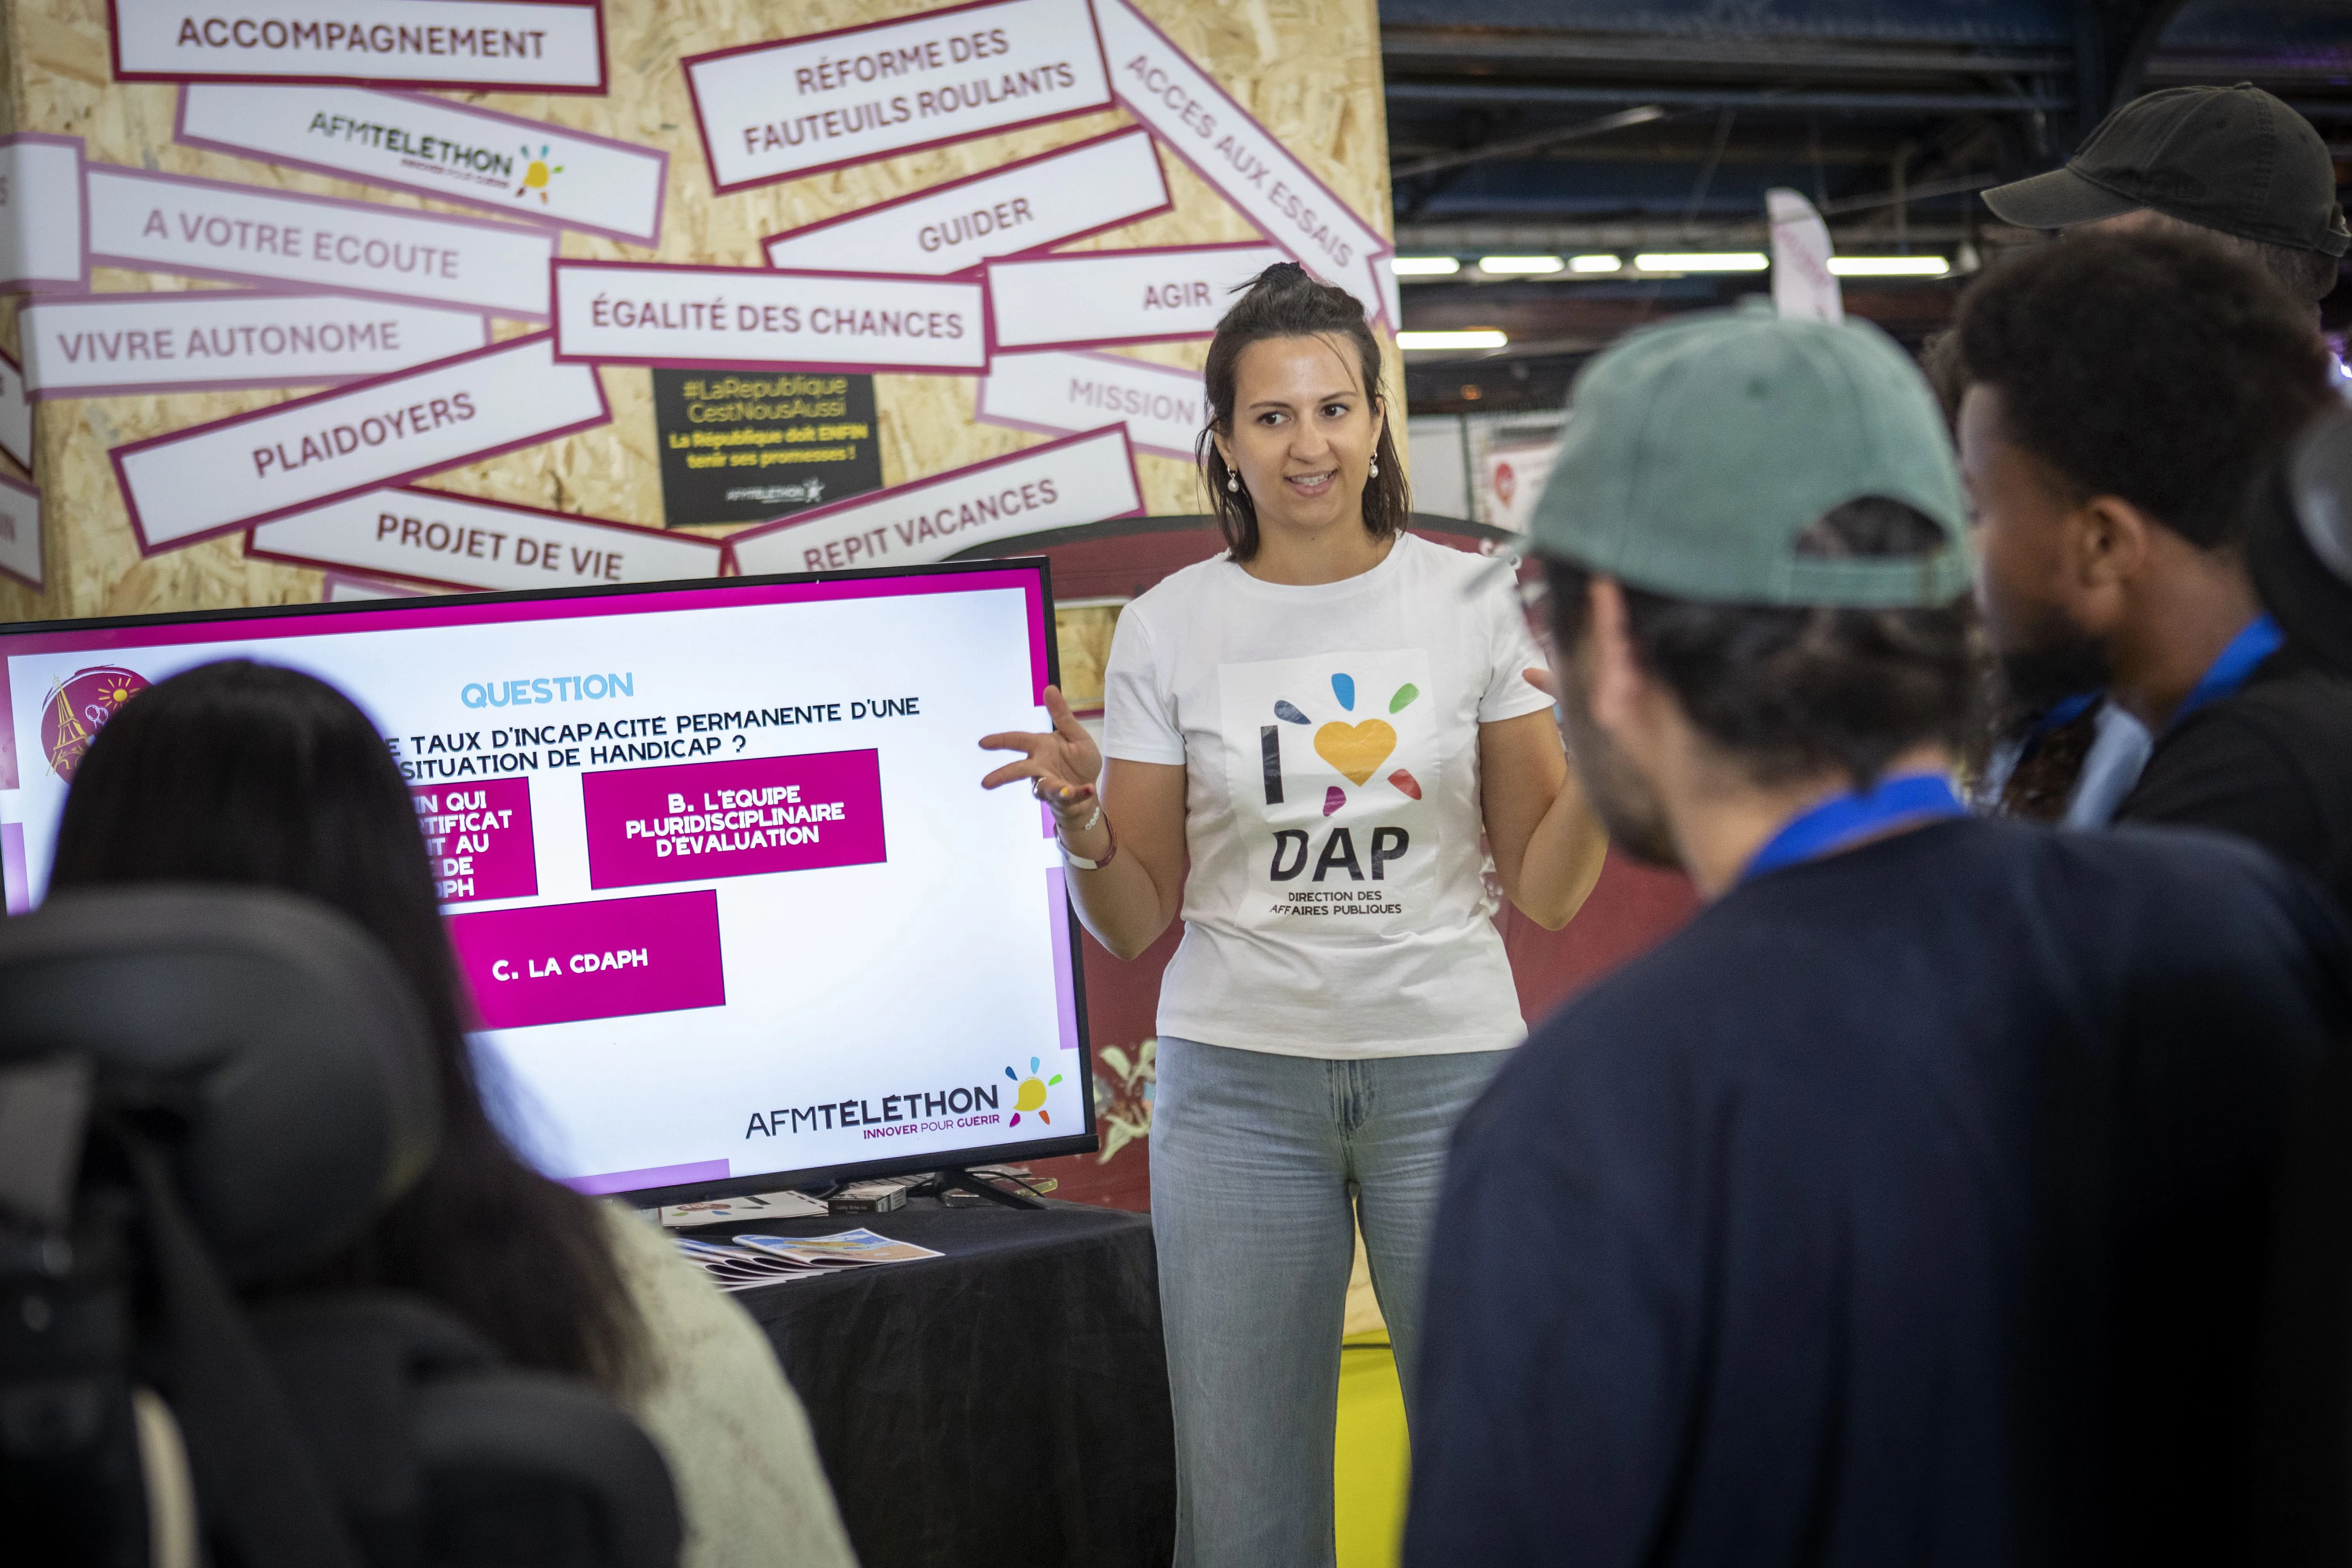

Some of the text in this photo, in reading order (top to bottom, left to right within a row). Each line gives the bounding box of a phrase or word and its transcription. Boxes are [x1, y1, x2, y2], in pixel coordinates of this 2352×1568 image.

[178, 17, 546, 59] ACCOMPAGNEMENT
[795, 29, 1009, 95] RÉFORME DES
[743, 63, 1075, 155] FAUTEUILS ROULANTS
[1126, 54, 1353, 267] ACCES AUX ESSAIS
[143, 210, 459, 279] A VOTRE ECOUTE
[919, 198, 1033, 252] GUIDER
[592, 292, 964, 339] ÉGALITÉ DES CHANCES
[1143, 282, 1213, 309] AGIR
[57, 322, 401, 363] VIVRE AUTONOME
[252, 392, 476, 478] PLAIDOYERS
[803, 479, 1058, 571] REPIT VACANCES
[377, 513, 624, 581] PROJET DE VIE
[461, 672, 633, 708] QUESTION
[410, 731, 481, 755] TAUX
[492, 716, 667, 748] D'INCAPACITÉ
[677, 702, 841, 734] PERMANENTE
[851, 697, 920, 720] D'UNE
[399, 735, 746, 780] SITUATION DE HANDICAP ?
[1261, 725, 1284, 805] I
[446, 790, 487, 811] QUI
[626, 802, 845, 839] PLURIDISCIPLINAIRE
[668, 785, 801, 814] B. L'ÉQUIPE
[456, 833, 489, 854] AU
[656, 826, 819, 858] D'ÉVALUATION
[1270, 827, 1410, 882] DAP
[443, 856, 474, 877] DE
[1270, 904, 1401, 915] AFFAIRES PUBLIQUES
[1289, 890, 1382, 902] DIRECTION DES
[492, 947, 648, 981] C. LA CDAPH
[746, 1085, 999, 1140] AFMTÉLÉTHON
[864, 1124, 918, 1140] INNOVER
[921, 1119, 954, 1132] POUR
